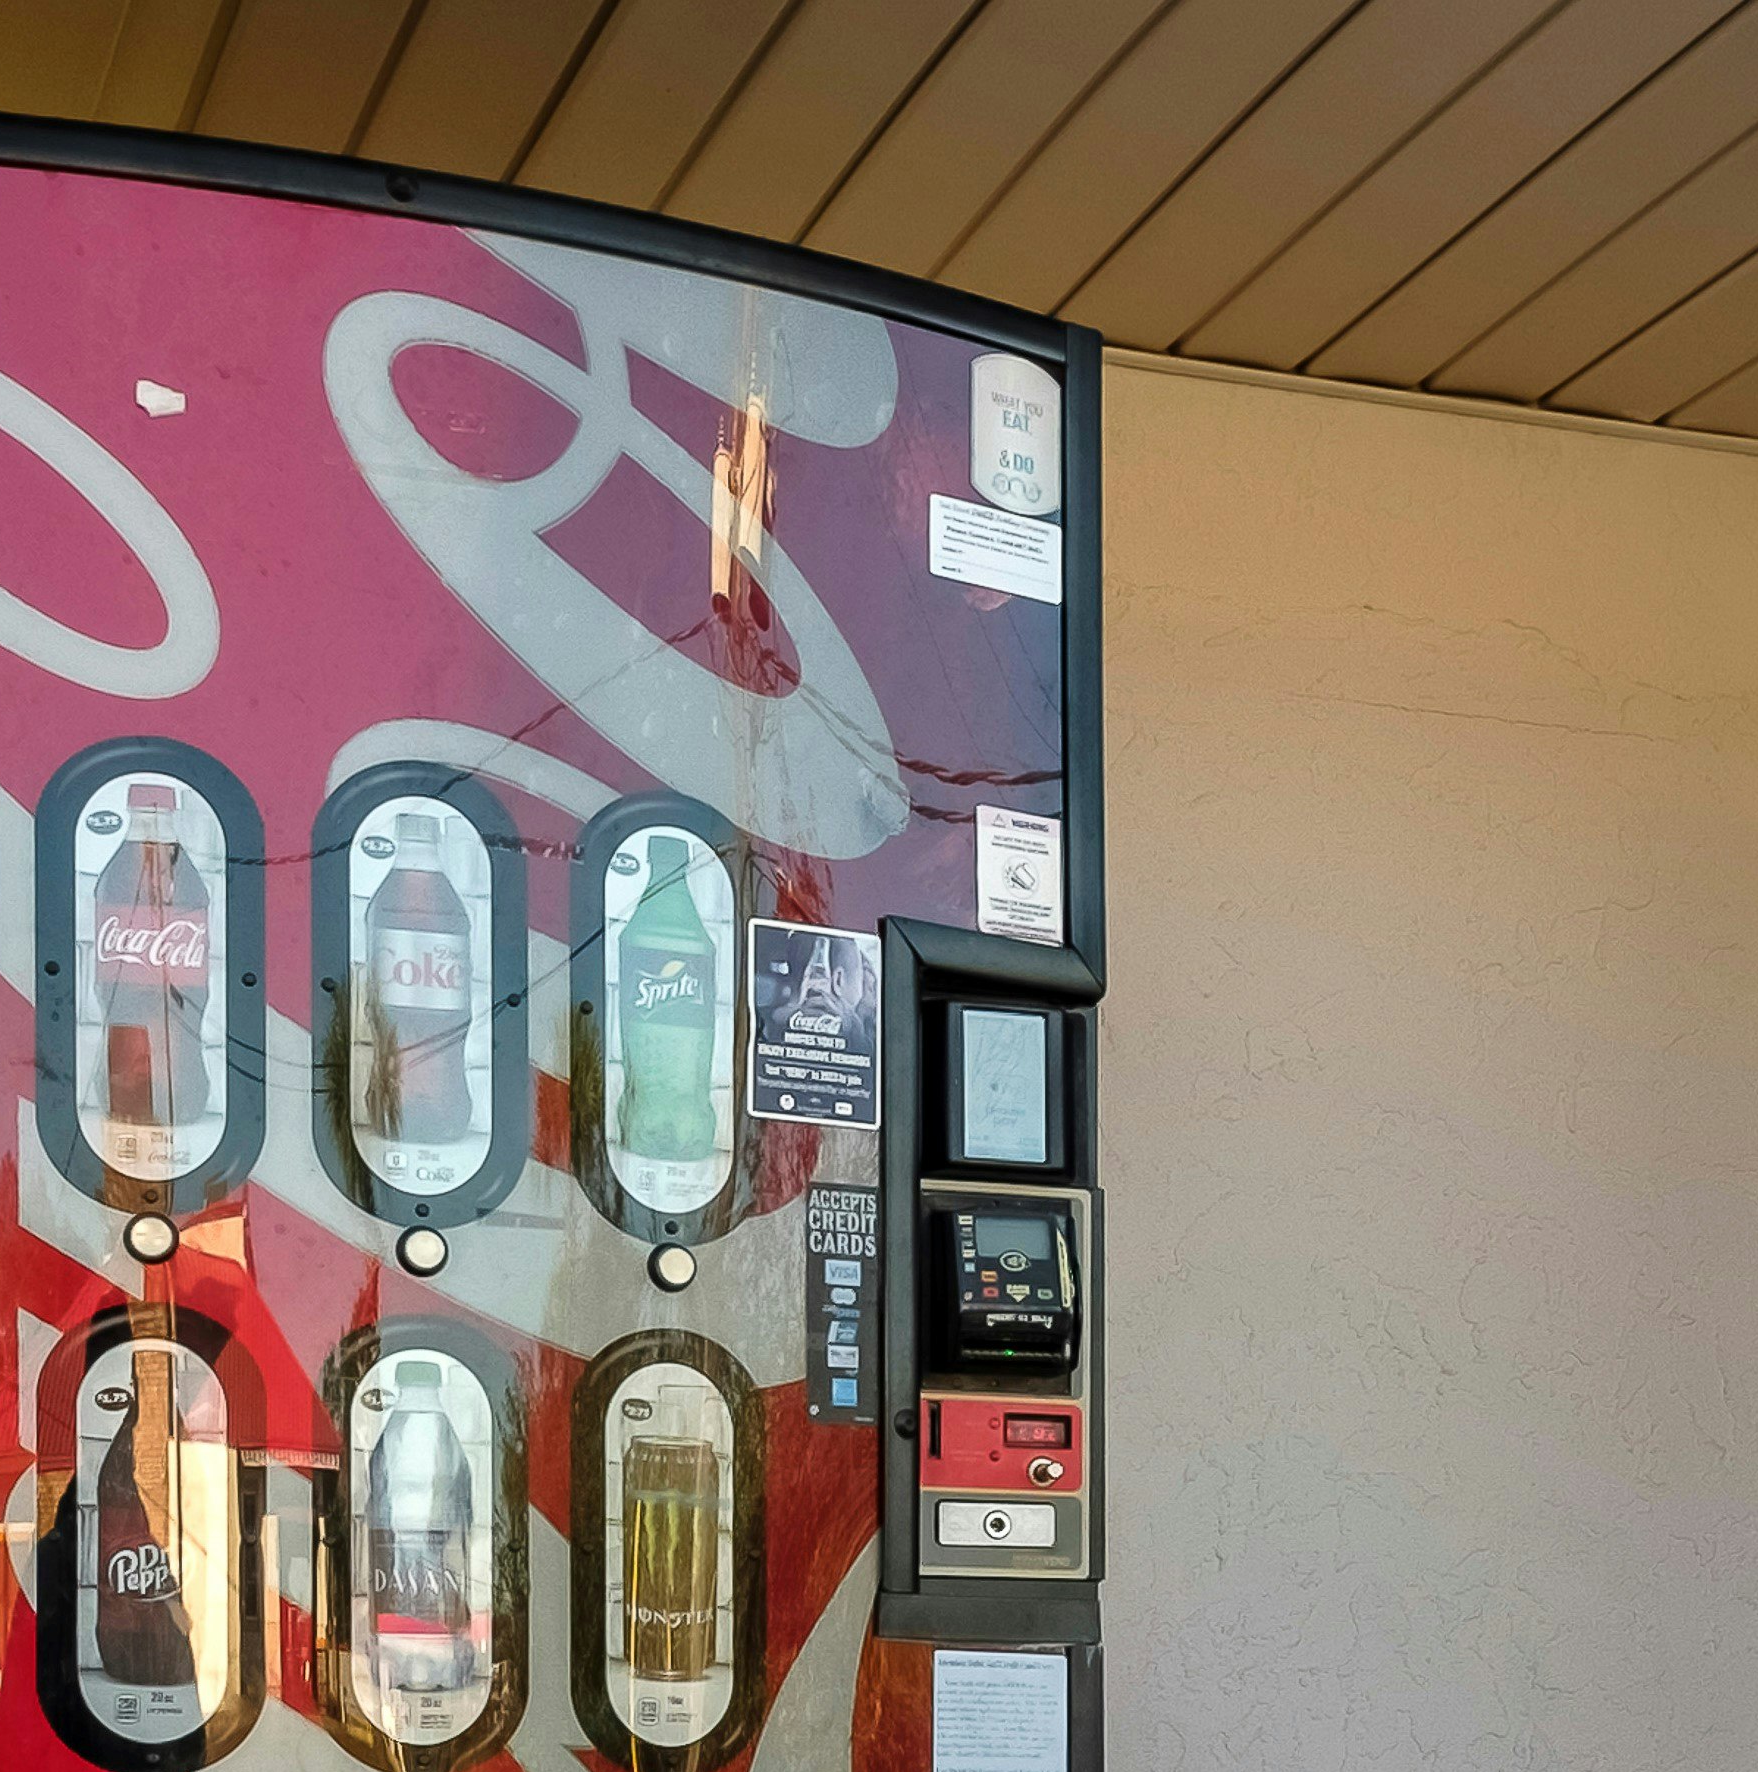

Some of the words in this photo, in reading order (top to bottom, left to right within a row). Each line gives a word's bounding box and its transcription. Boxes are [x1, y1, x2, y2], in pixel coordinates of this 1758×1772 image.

[1013, 453, 1035, 474] DO
[97, 914, 207, 968] Coca-Cola
[633, 970, 700, 1009] Sprite
[789, 1010, 843, 1036] Coca-Cola
[809, 1189, 877, 1213] ACCEPTS
[808, 1209, 877, 1235] CREDIT
[809, 1231, 877, 1258] CARDS
[828, 1262, 858, 1279] VISA
[421, 1696, 432, 1708] 20
